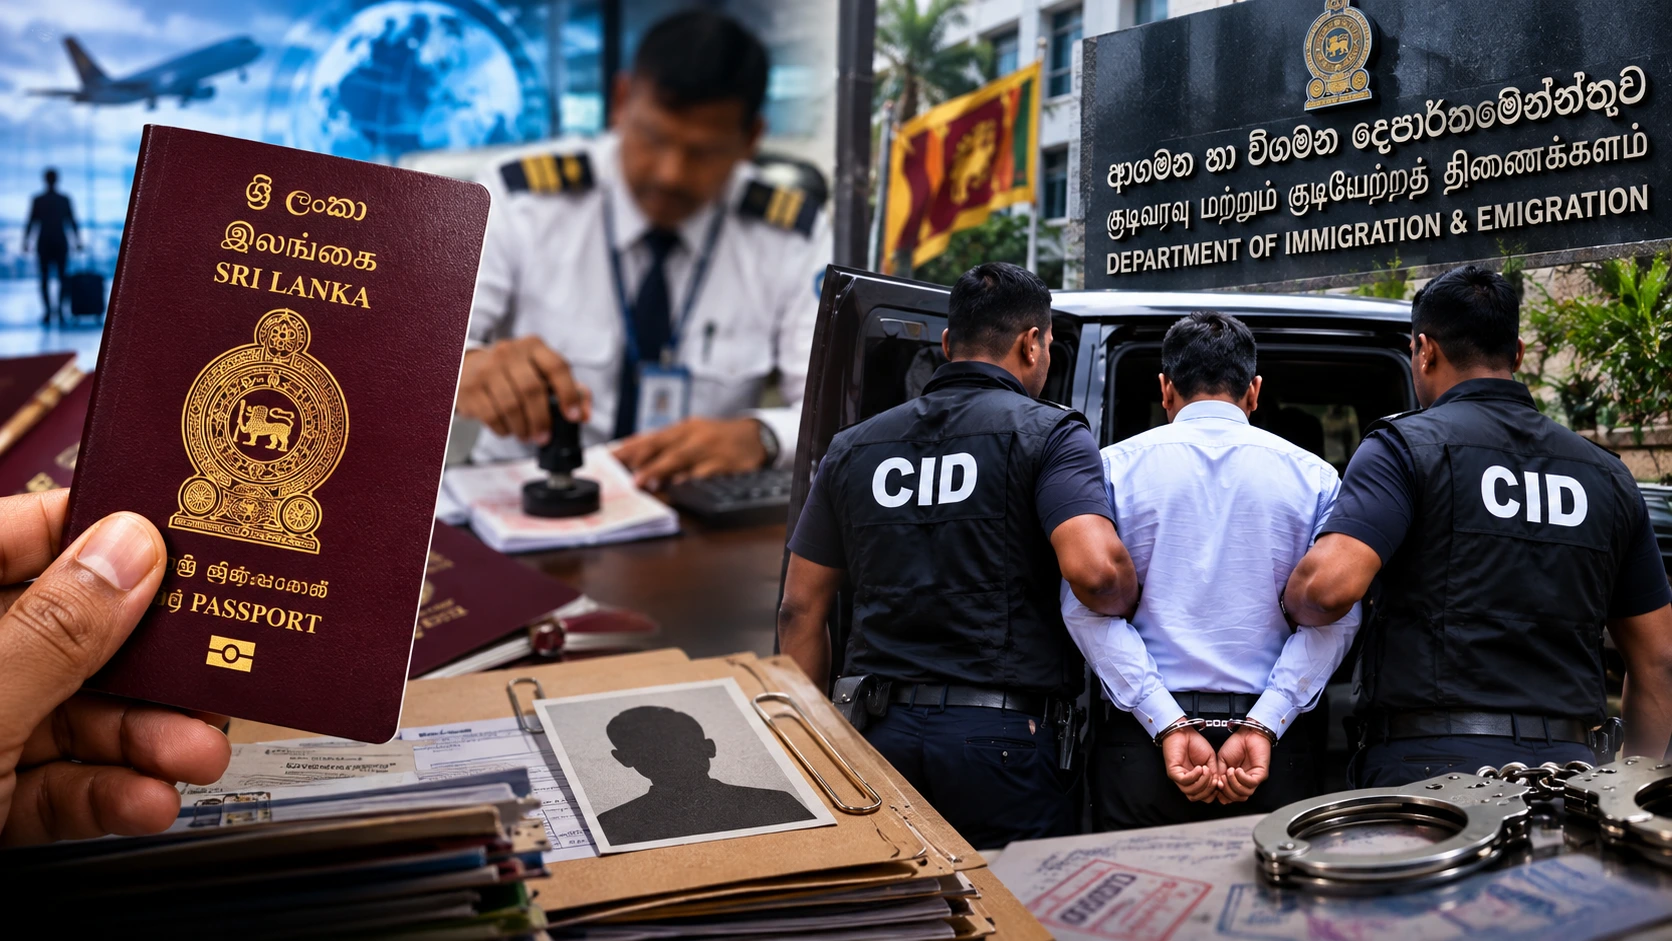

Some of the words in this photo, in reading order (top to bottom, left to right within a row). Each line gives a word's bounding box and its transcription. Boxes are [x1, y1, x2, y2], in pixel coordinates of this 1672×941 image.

[1106, 148, 1195, 195] ආගමන
[1205, 143, 1236, 174] හා
[1247, 123, 1339, 167] විගමන
[1106, 200, 1190, 241] குடிவரவு
[1200, 179, 1279, 225] மற்றும்
[1287, 156, 1430, 217] குடியேற்றத்
[1443, 122, 1648, 197] திணைக்களம்
[286, 190, 368, 223] ලංකා
[1106, 237, 1242, 275] DEPARTMENT
[1248, 233, 1279, 260] OF
[1284, 211, 1442, 255] IMMIGRATION
[1449, 208, 1468, 236] &
[1477, 183, 1649, 232] EMIGRATION
[219, 219, 378, 273] இலங்கை
[213, 261, 263, 290] SRI
[267, 270, 372, 310] LANKA
[871, 452, 978, 508] CID
[1480, 465, 1589, 527] CID
[189, 592, 323, 634] PASSPORT
